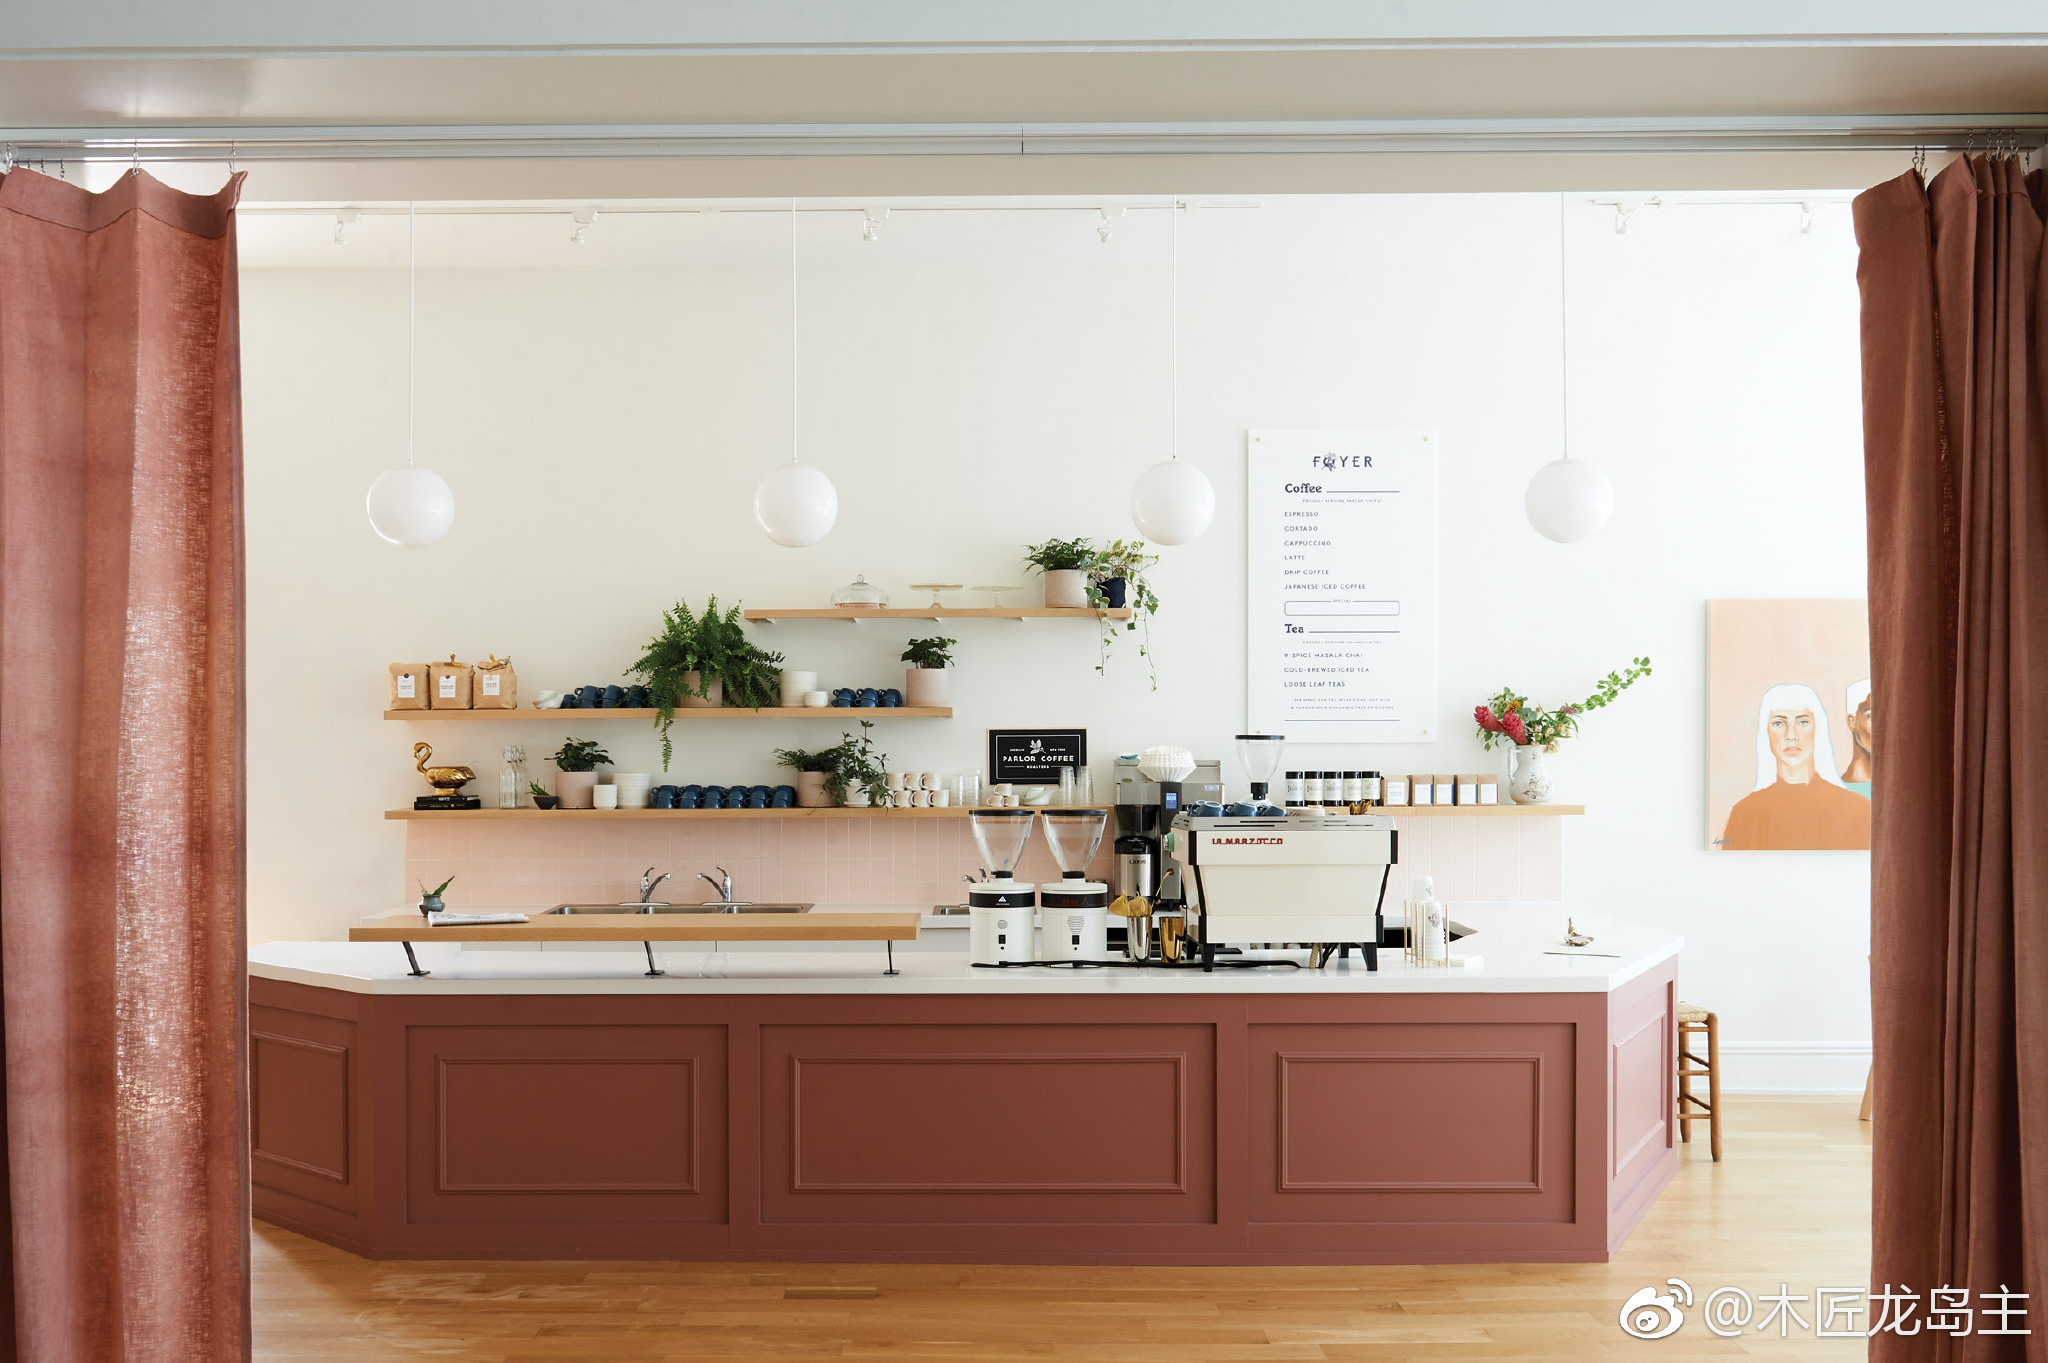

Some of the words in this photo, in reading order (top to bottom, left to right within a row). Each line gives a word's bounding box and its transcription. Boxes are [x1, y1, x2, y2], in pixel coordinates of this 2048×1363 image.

[1313, 455, 1373, 468] FOYER
[1285, 482, 1322, 493] Coffee
[1284, 624, 1304, 633] Tea
